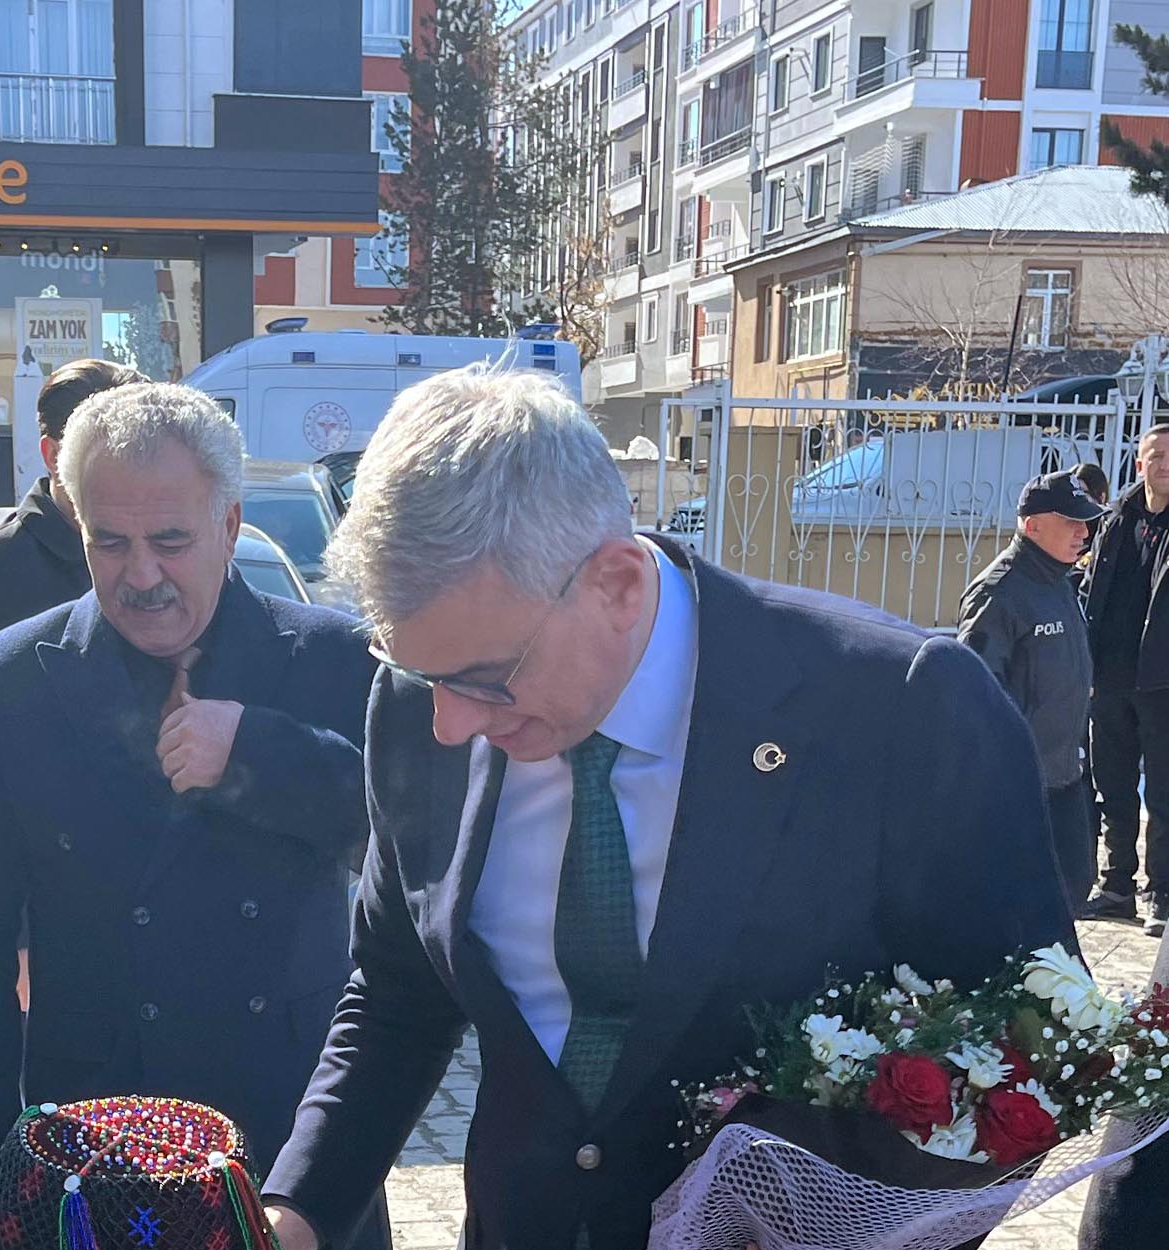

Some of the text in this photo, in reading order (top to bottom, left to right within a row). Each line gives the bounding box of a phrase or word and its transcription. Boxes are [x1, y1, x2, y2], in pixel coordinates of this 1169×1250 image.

[21, 249, 104, 272] mondi
[29, 319, 87, 339] ZAM YOK
